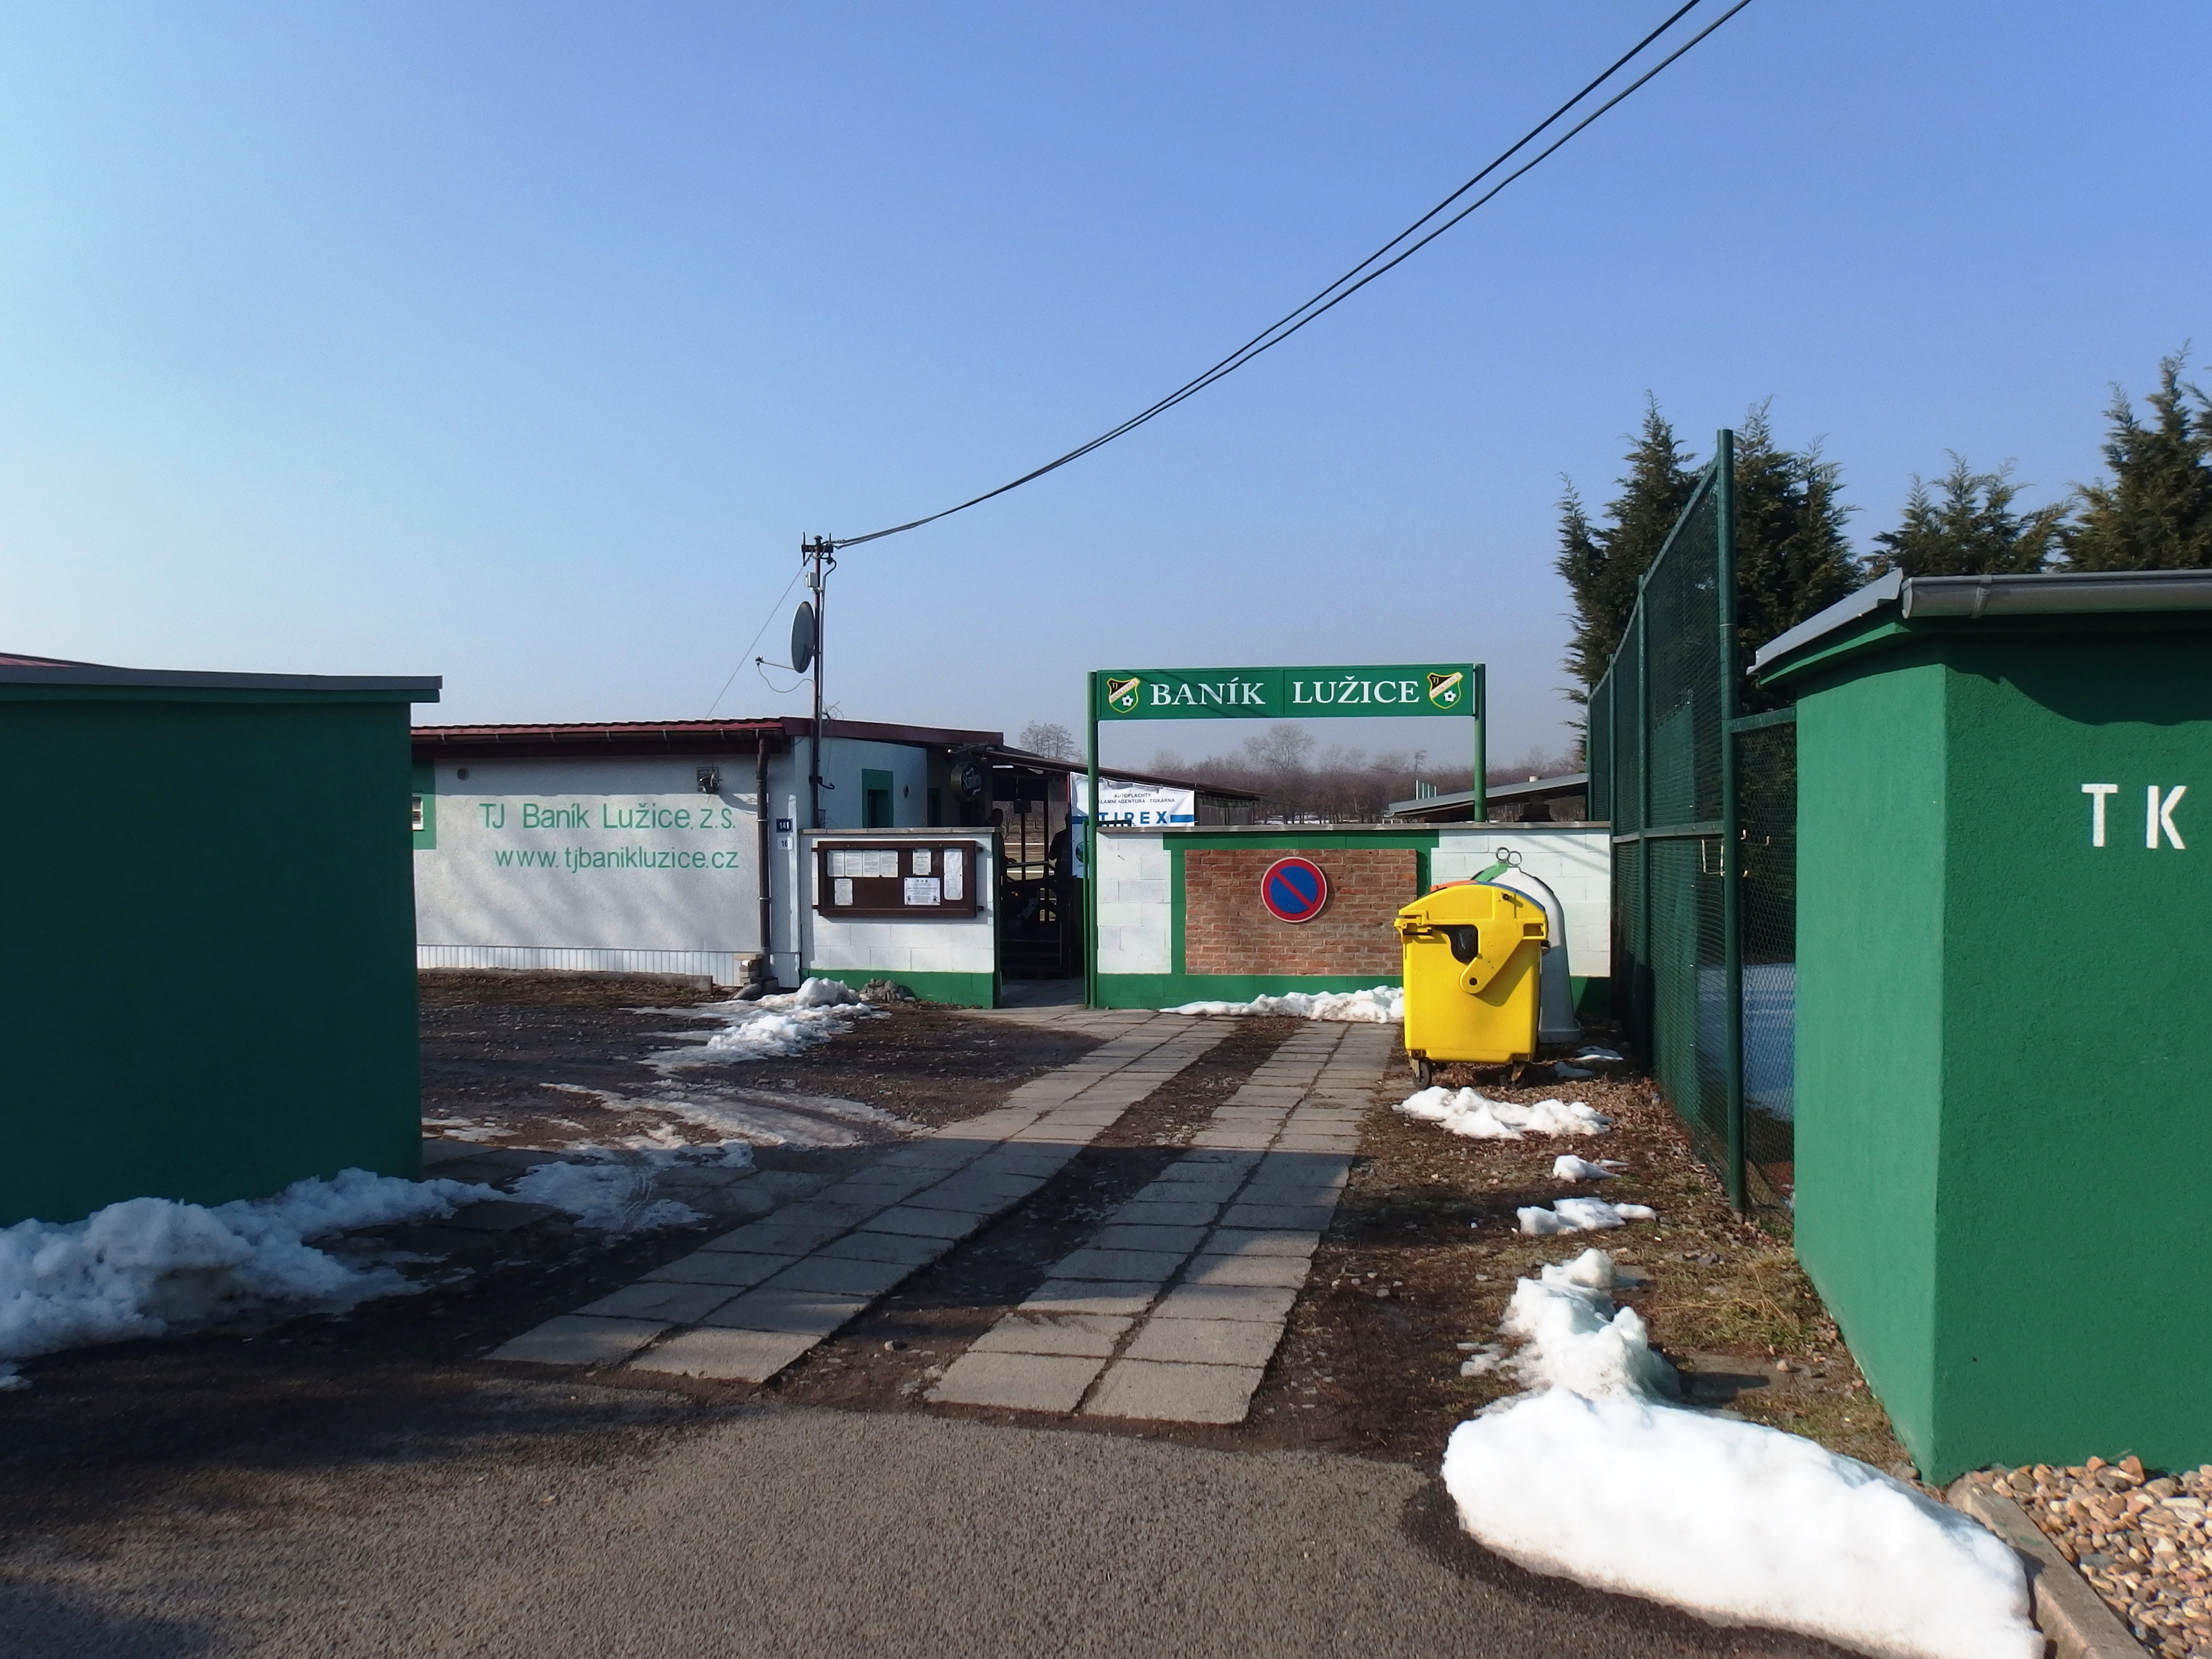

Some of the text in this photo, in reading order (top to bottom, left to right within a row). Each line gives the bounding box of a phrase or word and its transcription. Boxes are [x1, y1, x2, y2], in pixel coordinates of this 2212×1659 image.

[1150, 675, 1420, 705] BANÍK LUŽICE
[479, 803, 505, 829] TJ
[523, 803, 590, 829] Baník
